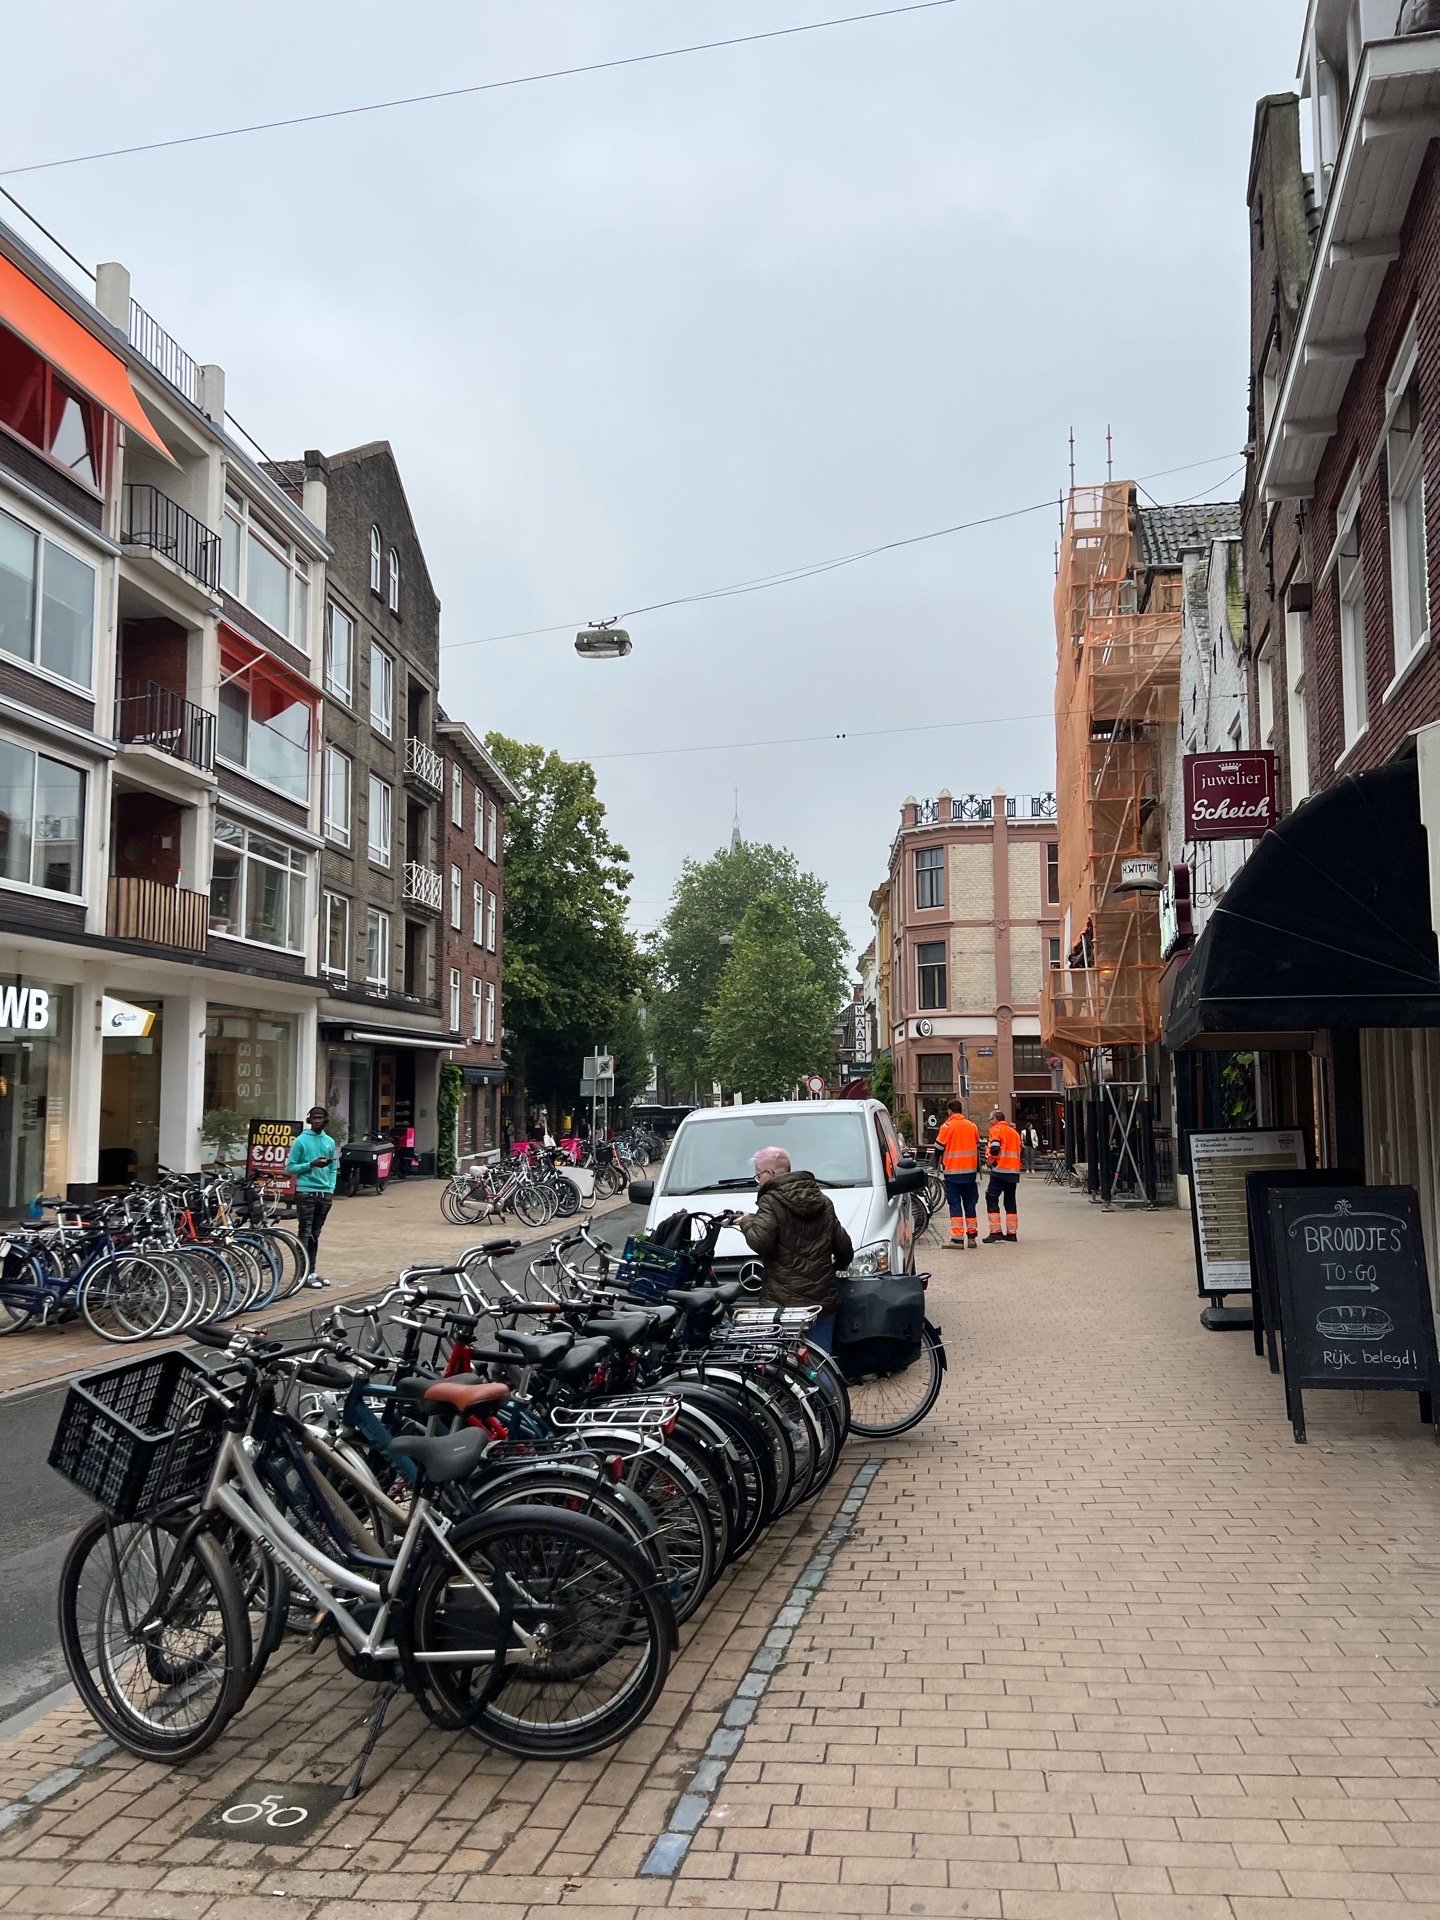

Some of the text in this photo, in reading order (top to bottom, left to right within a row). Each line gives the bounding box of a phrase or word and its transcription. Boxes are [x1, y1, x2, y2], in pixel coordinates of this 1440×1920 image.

[1201, 772, 1260, 790] juwelier
[1191, 796, 1270, 820] Scheich
[856, 1006, 864, 1050] KAAS
[259, 1124, 291, 1136] GOUD
[1304, 1226, 1401, 1253] BROODJES
[1320, 1262, 1377, 1281] TO-GO
[1362, 1349, 1417, 1370] belegd!
